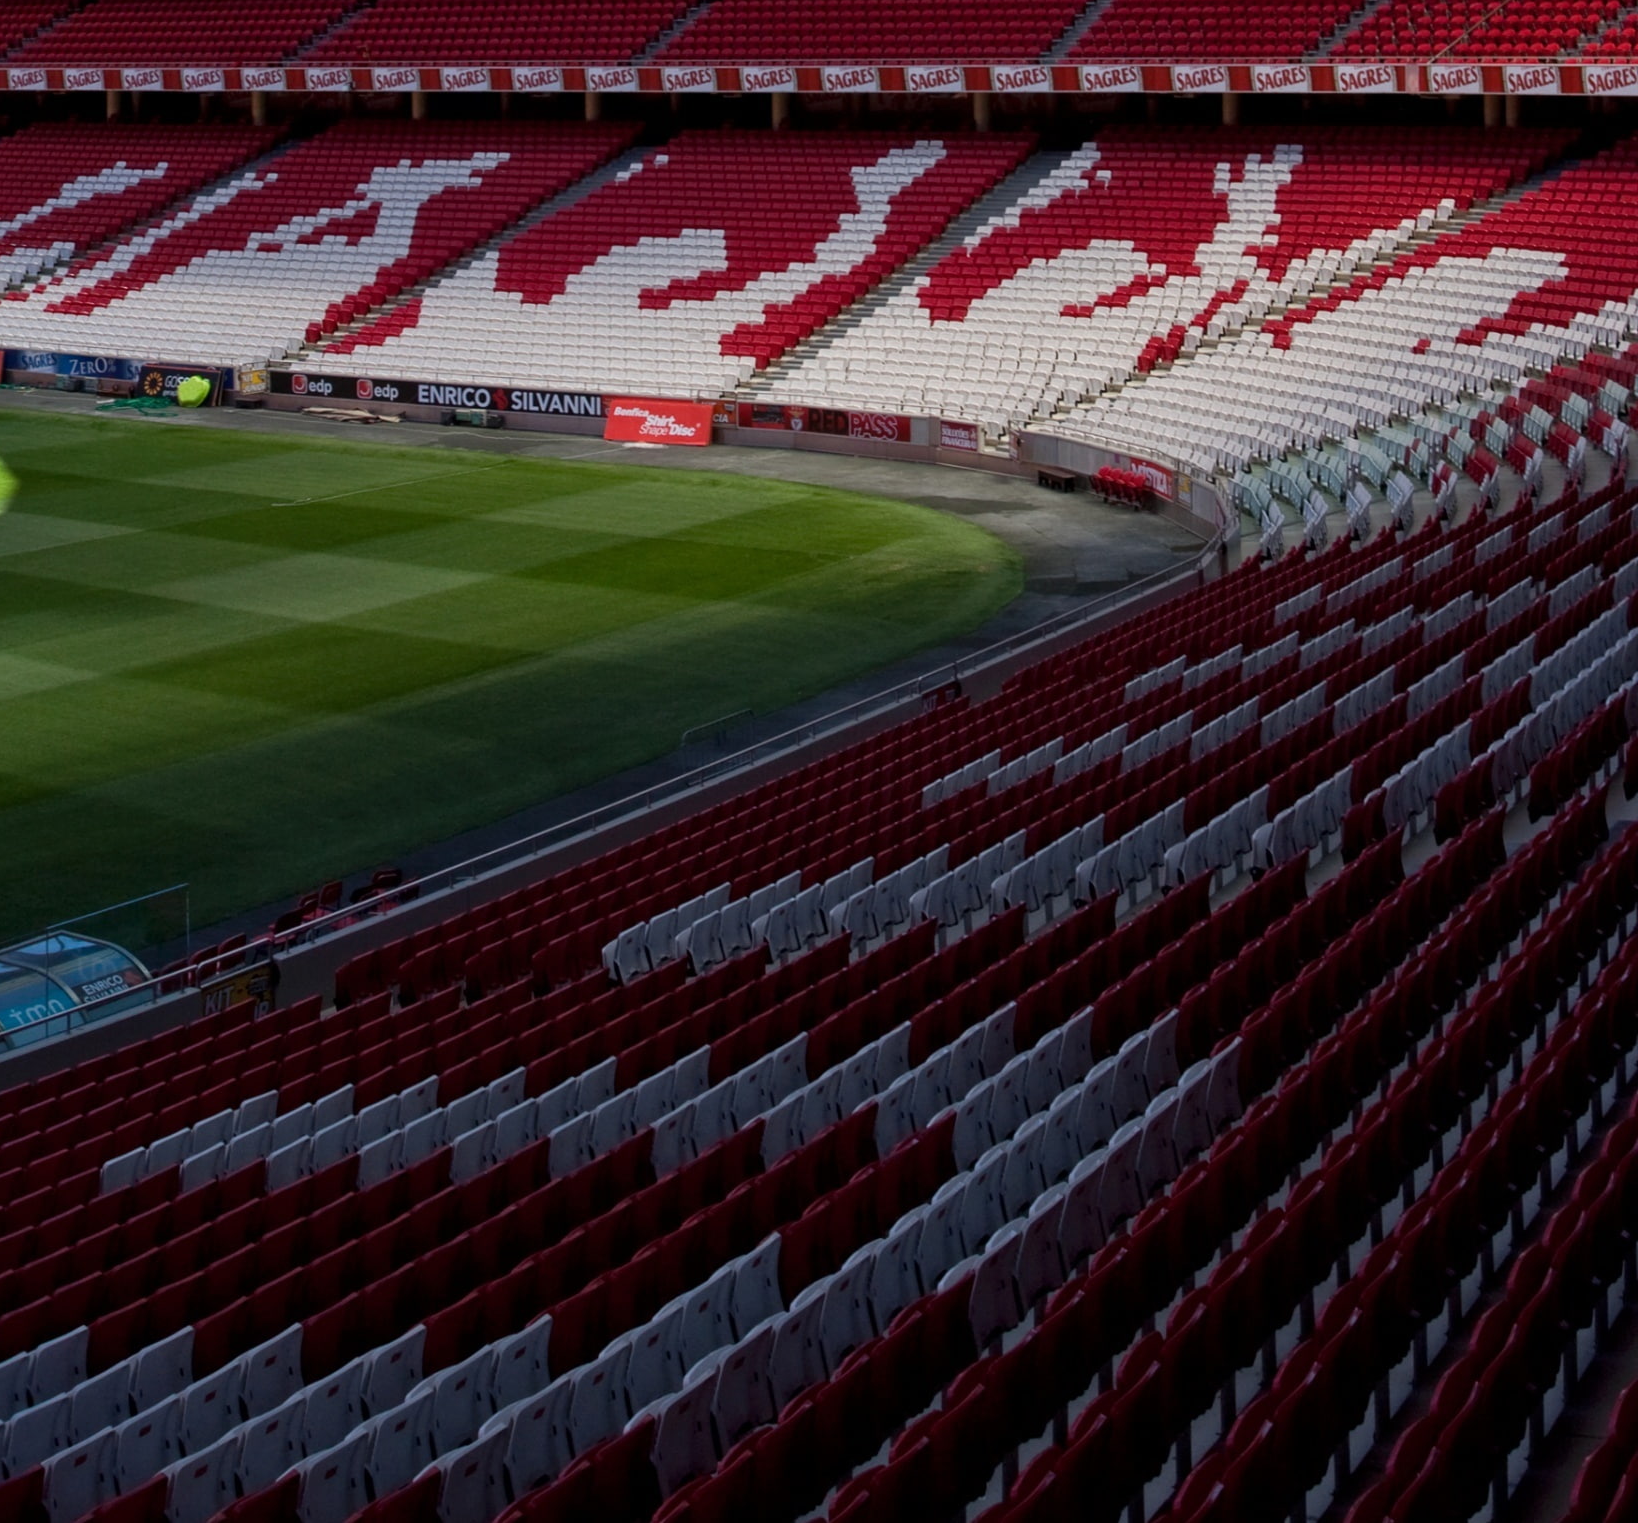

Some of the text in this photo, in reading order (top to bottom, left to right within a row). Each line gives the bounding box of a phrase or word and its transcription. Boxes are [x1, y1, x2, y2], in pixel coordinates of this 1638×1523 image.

[517, 68, 559, 90] SAGRES
[1340, 65, 1391, 91] SAGRES
[20, 353, 58, 370] SAGRES
[308, 380, 333, 396] edp
[374, 384, 399, 402] edp
[418, 384, 602, 416] ENRICO SILVANNI
[613, 406, 676, 427] Benfica Shirt
[669, 424, 696, 437] Disc
[849, 413, 899, 443] PASS
[205, 987, 235, 1016] KIT
